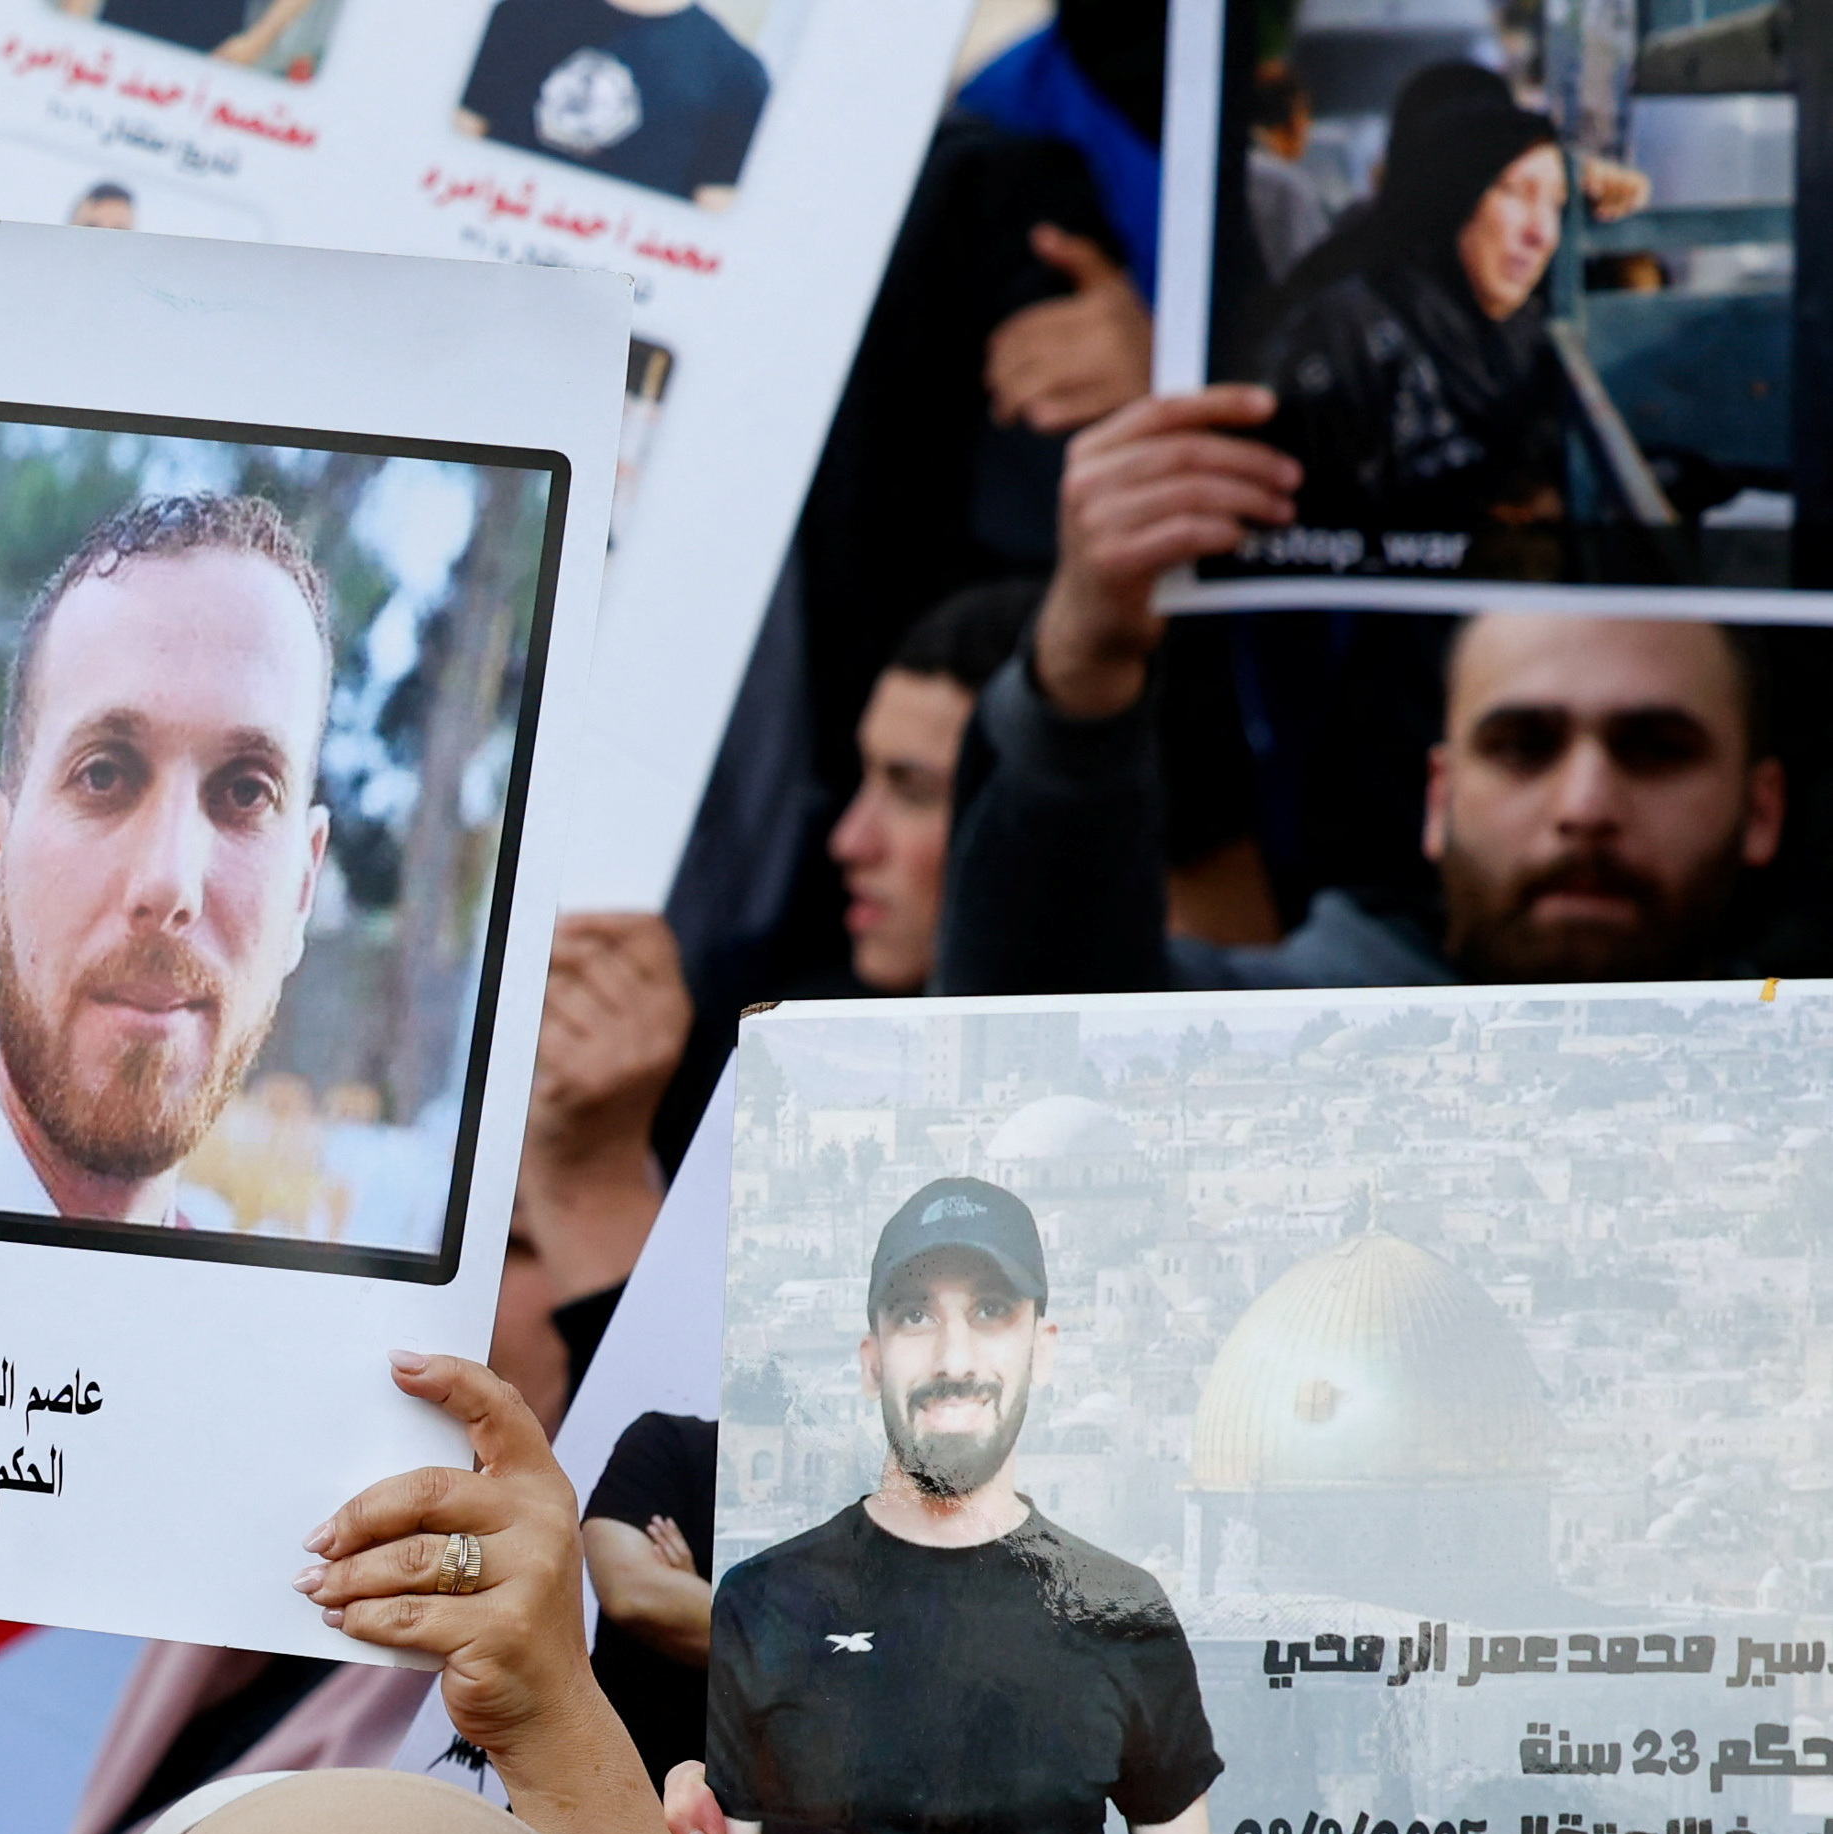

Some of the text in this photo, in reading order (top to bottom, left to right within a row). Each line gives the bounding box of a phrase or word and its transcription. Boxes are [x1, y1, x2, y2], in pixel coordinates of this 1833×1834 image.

[25, 1369, 103, 1435] عاصم
[1264, 1622, 1833, 1689] سير محمد عمر الرمحي
[1519, 1722, 1622, 1775] سنة
[1632, 1730, 1700, 1777] 23
